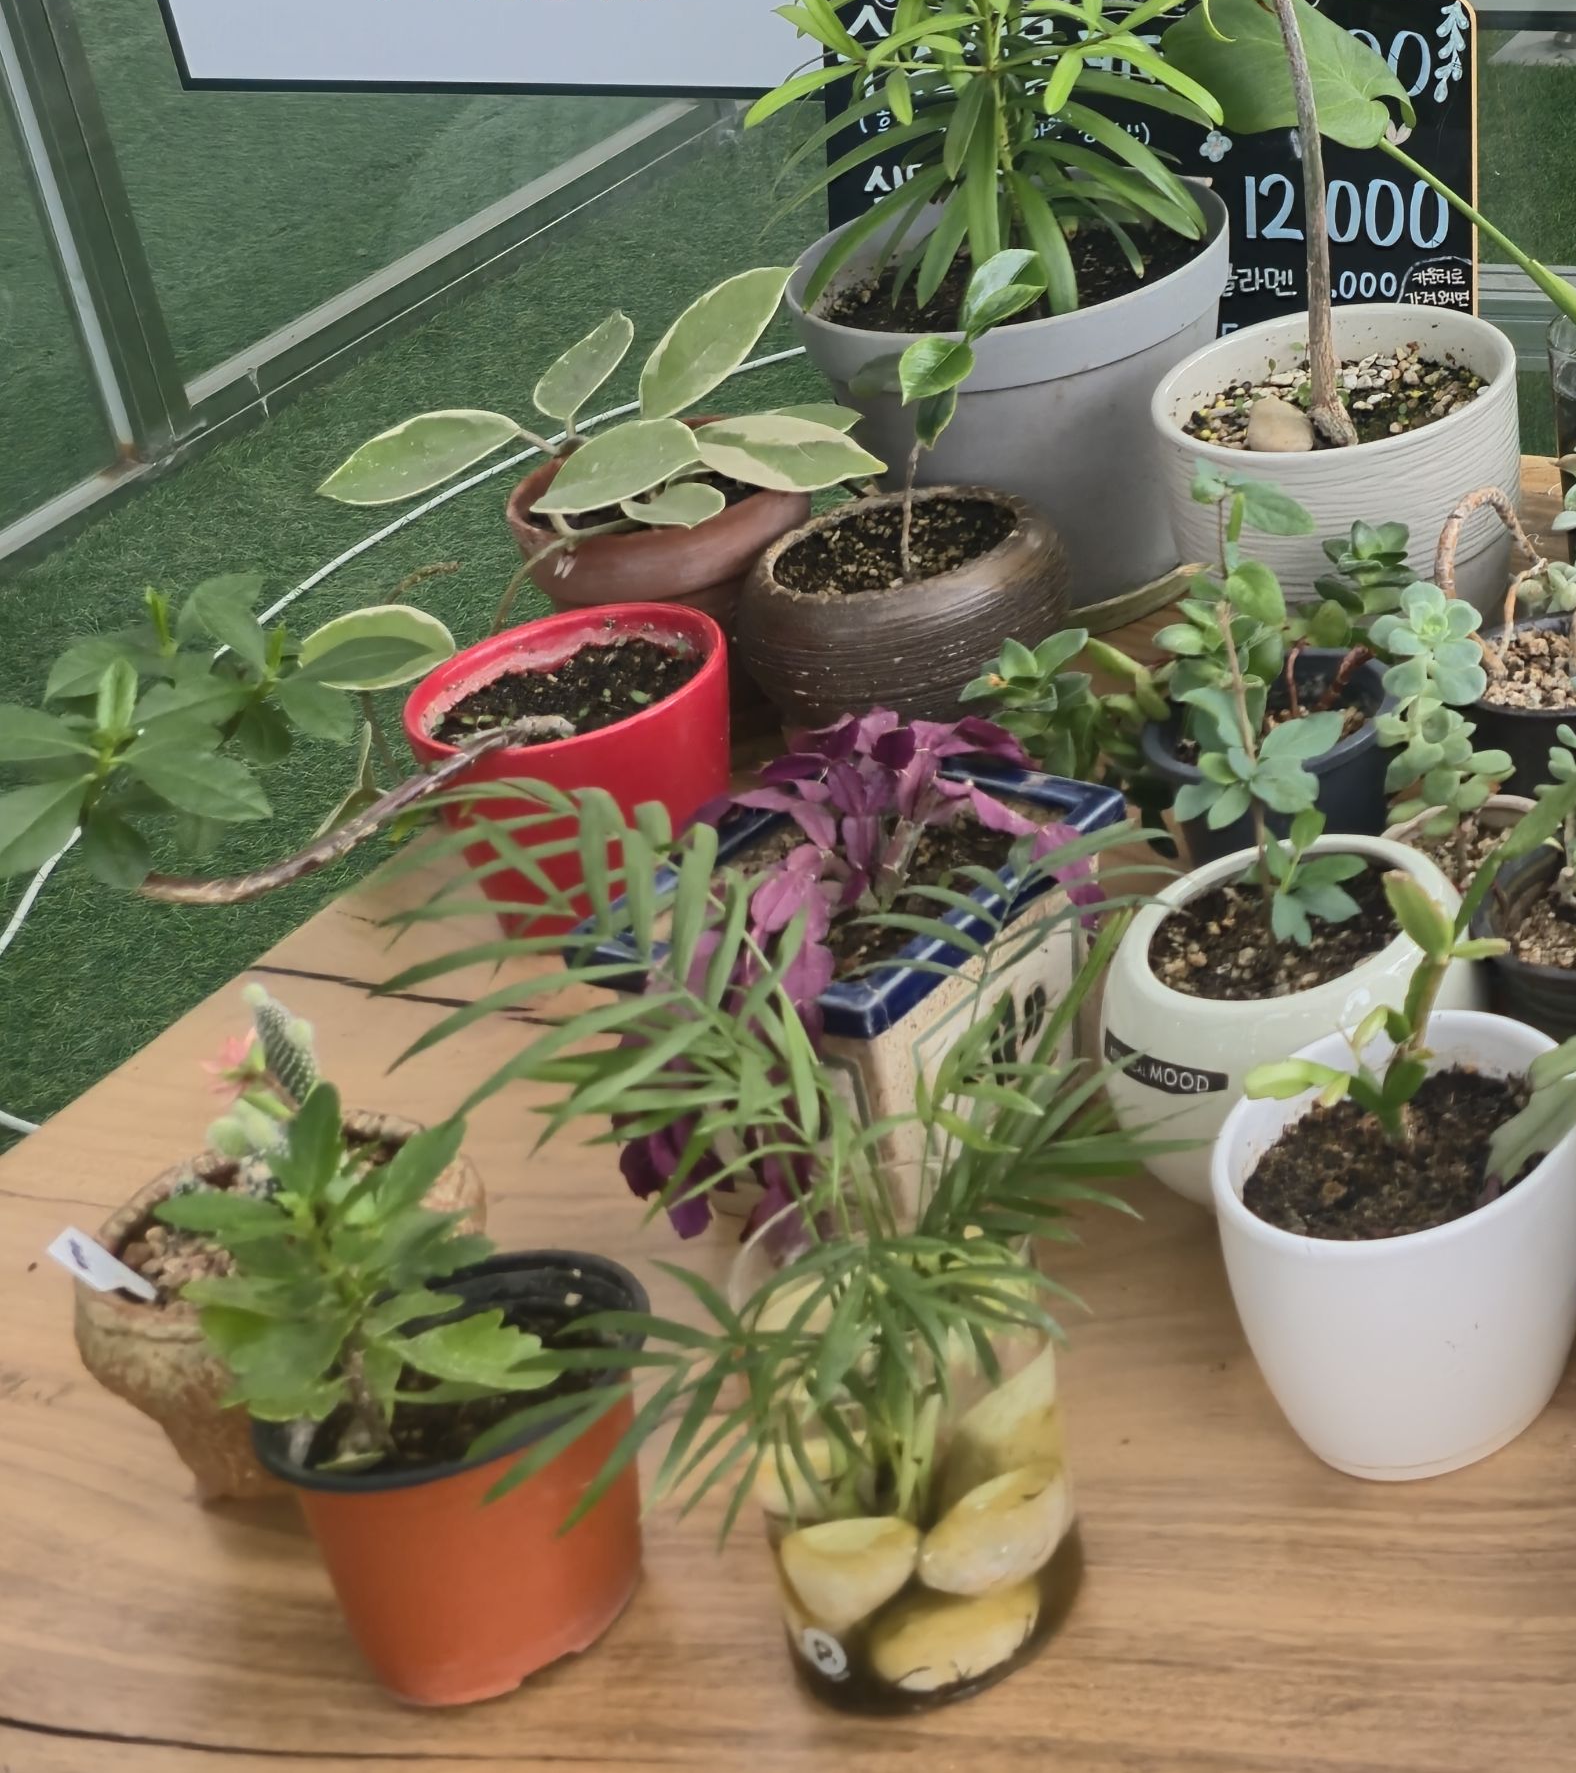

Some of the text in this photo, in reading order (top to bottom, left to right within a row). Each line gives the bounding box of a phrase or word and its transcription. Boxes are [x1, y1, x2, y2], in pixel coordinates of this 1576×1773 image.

[1245, 173, 1450, 249] 12000
[1411, 267, 1466, 286] 카운터로
[1149, 1063, 1209, 1093] MOOD
